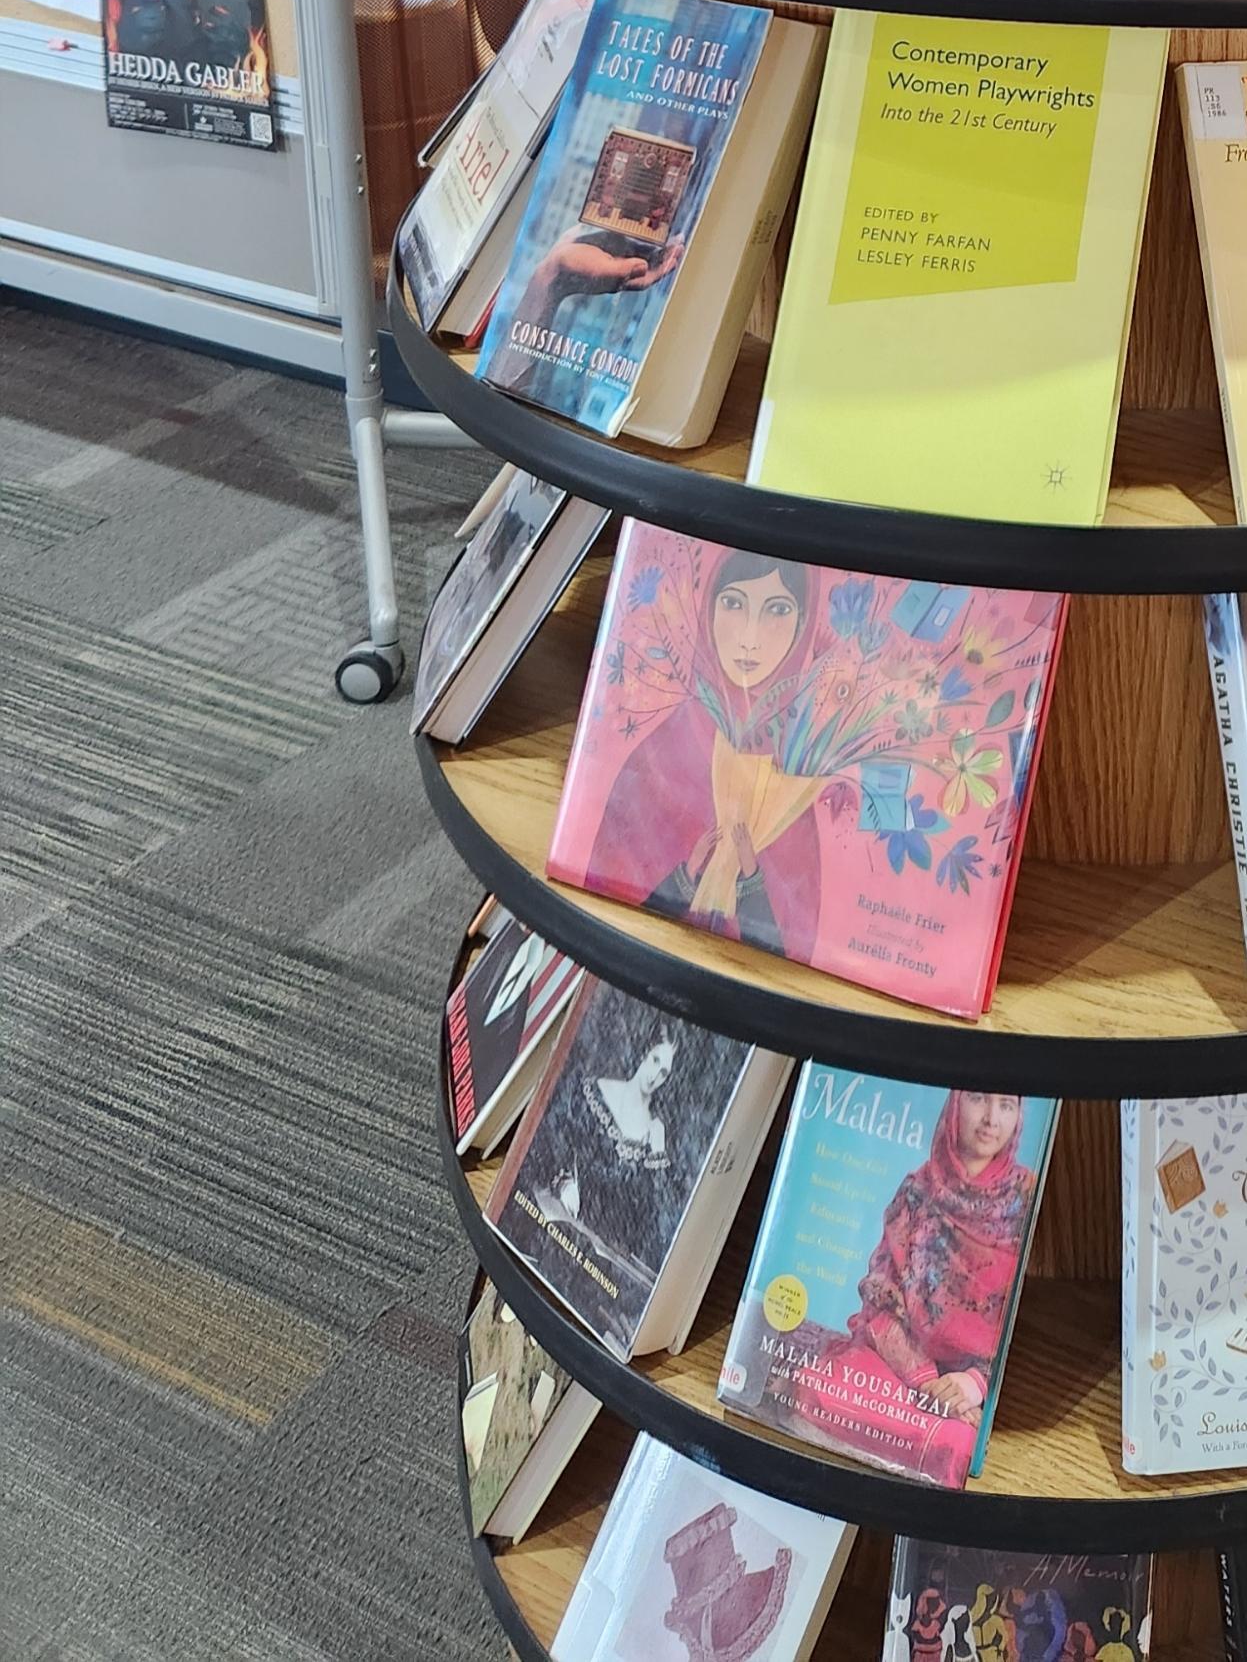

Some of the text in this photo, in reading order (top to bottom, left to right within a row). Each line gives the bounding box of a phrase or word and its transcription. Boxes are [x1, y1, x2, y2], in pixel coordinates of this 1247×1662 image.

[608, 20, 729, 69] TALES OF THE
[892, 40, 1049, 78] Contemporary
[109, 51, 184, 84] HEDDA
[186, 62, 264, 94] GABLER
[597, 51, 739, 106] LOST FORMICANS
[888, 71, 1095, 111] Women Playwrights
[626, 90, 729, 120] AND OTHER PLAYS
[880, 103, 1057, 139] Into the 21st Century
[864, 207, 939, 223] EDITED BY
[861, 227, 991, 252] PENNY FARFAN
[857, 250, 976, 273] LESLEY FERRIS
[508, 342, 584, 373] INTRODUCTION BY
[511, 320, 590, 363] CONSTANCE
[1213, 655, 1247, 876] AGATHA CHRISTIE
[915, 913, 947, 934] Frier
[896, 952, 937, 978] Fronty
[802, 1072, 926, 1151] Malala
[514, 1190, 619, 1299] EDITED BY CHARLES ROBINSON
[759, 1335, 952, 1418] MALALA YOUSAFZAI
[770, 1365, 930, 1430] with PATRICIA McCORMICK
[773, 1392, 914, 1451] YOUNG READERS EDITION
[1202, 1442, 1224, 1453] With
